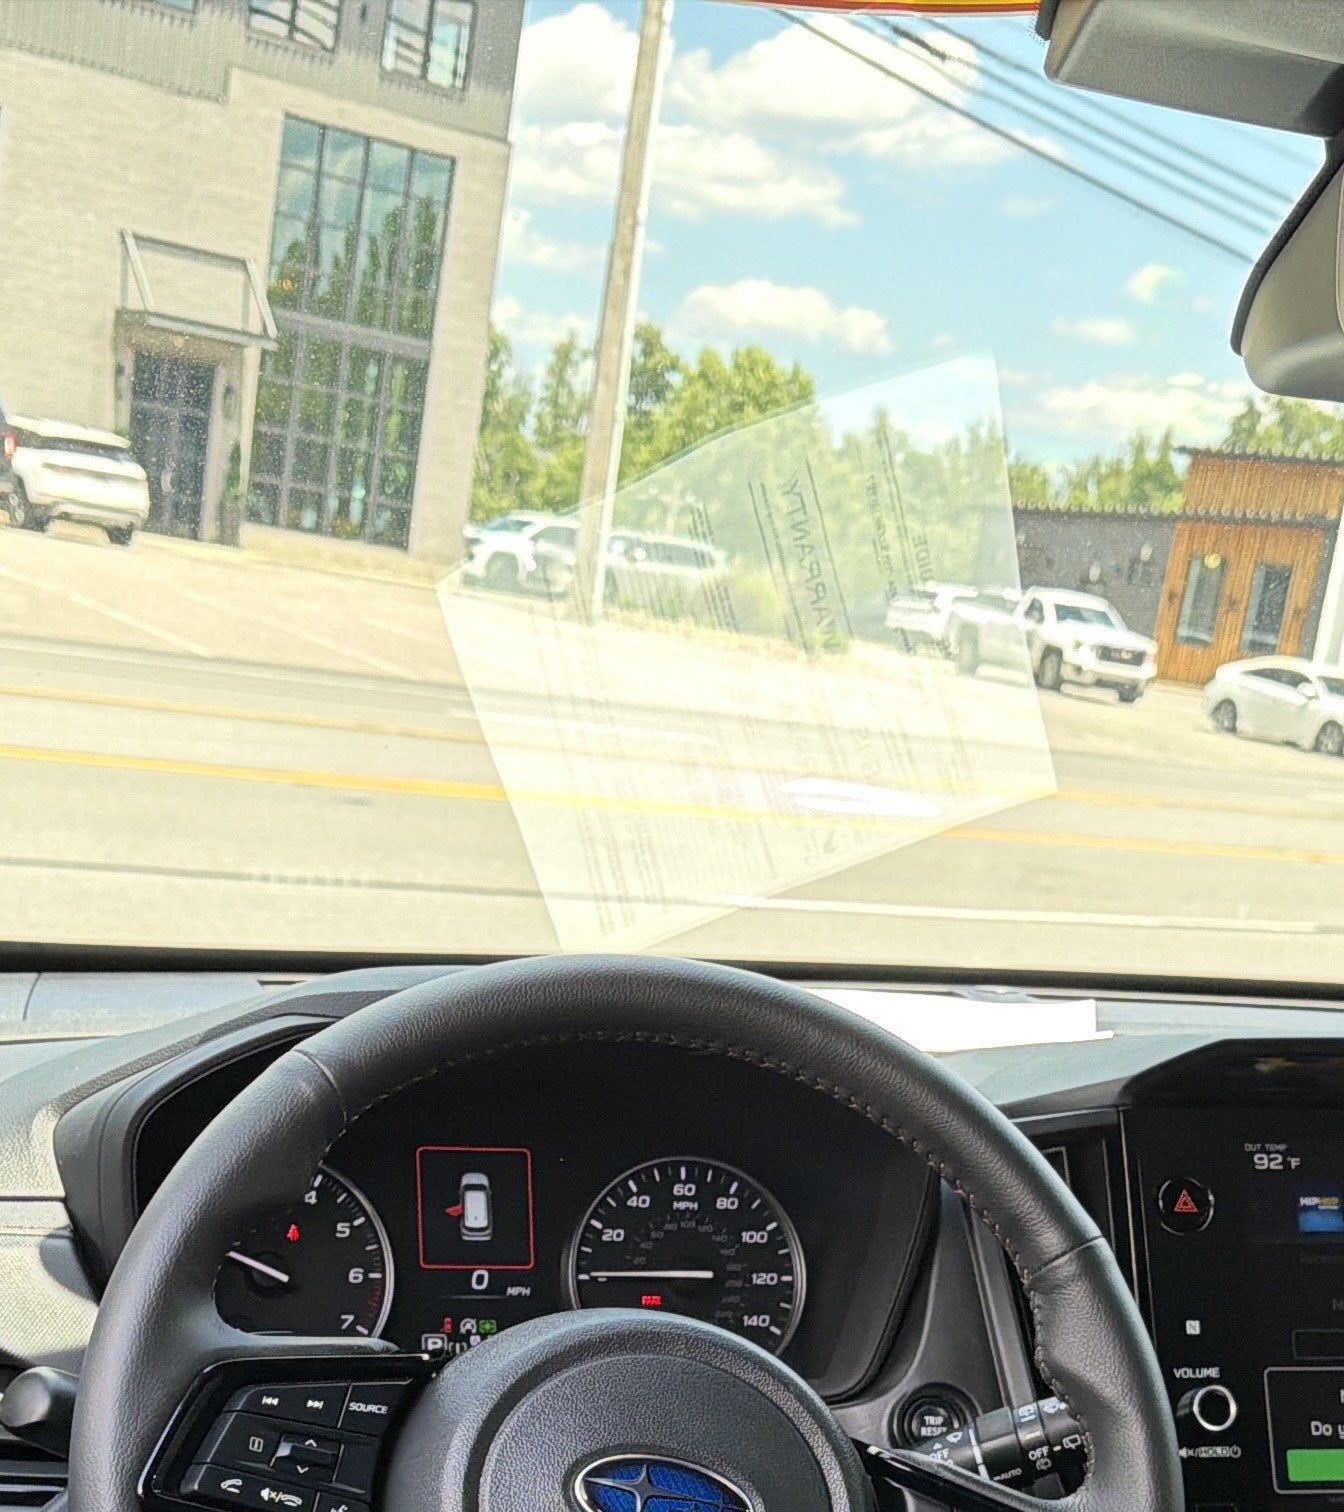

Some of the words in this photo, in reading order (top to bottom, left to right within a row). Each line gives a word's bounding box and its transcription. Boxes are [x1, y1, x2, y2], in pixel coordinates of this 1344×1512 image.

[673, 1183, 696, 1196] 60
[305, 1190, 318, 1205] 4
[627, 1195, 650, 1208] 40
[715, 1198, 739, 1210] 80
[673, 1201, 698, 1210] MPH
[335, 1222, 351, 1238] 5
[601, 1229, 625, 1242] 20
[741, 1231, 768, 1244] 100
[348, 1268, 364, 1284] 6
[471, 1269, 489, 1290] 0
[751, 1272, 778, 1285] 120
[340, 1314, 355, 1330] 7
[742, 1315, 770, 1327] 140
[1173, 1366, 1221, 1379] VOLUME
[348, 1401, 388, 1414] SOURCE
[1311, 1421, 1332, 1436] Do
[1028, 1445, 1049, 1461] OFF
